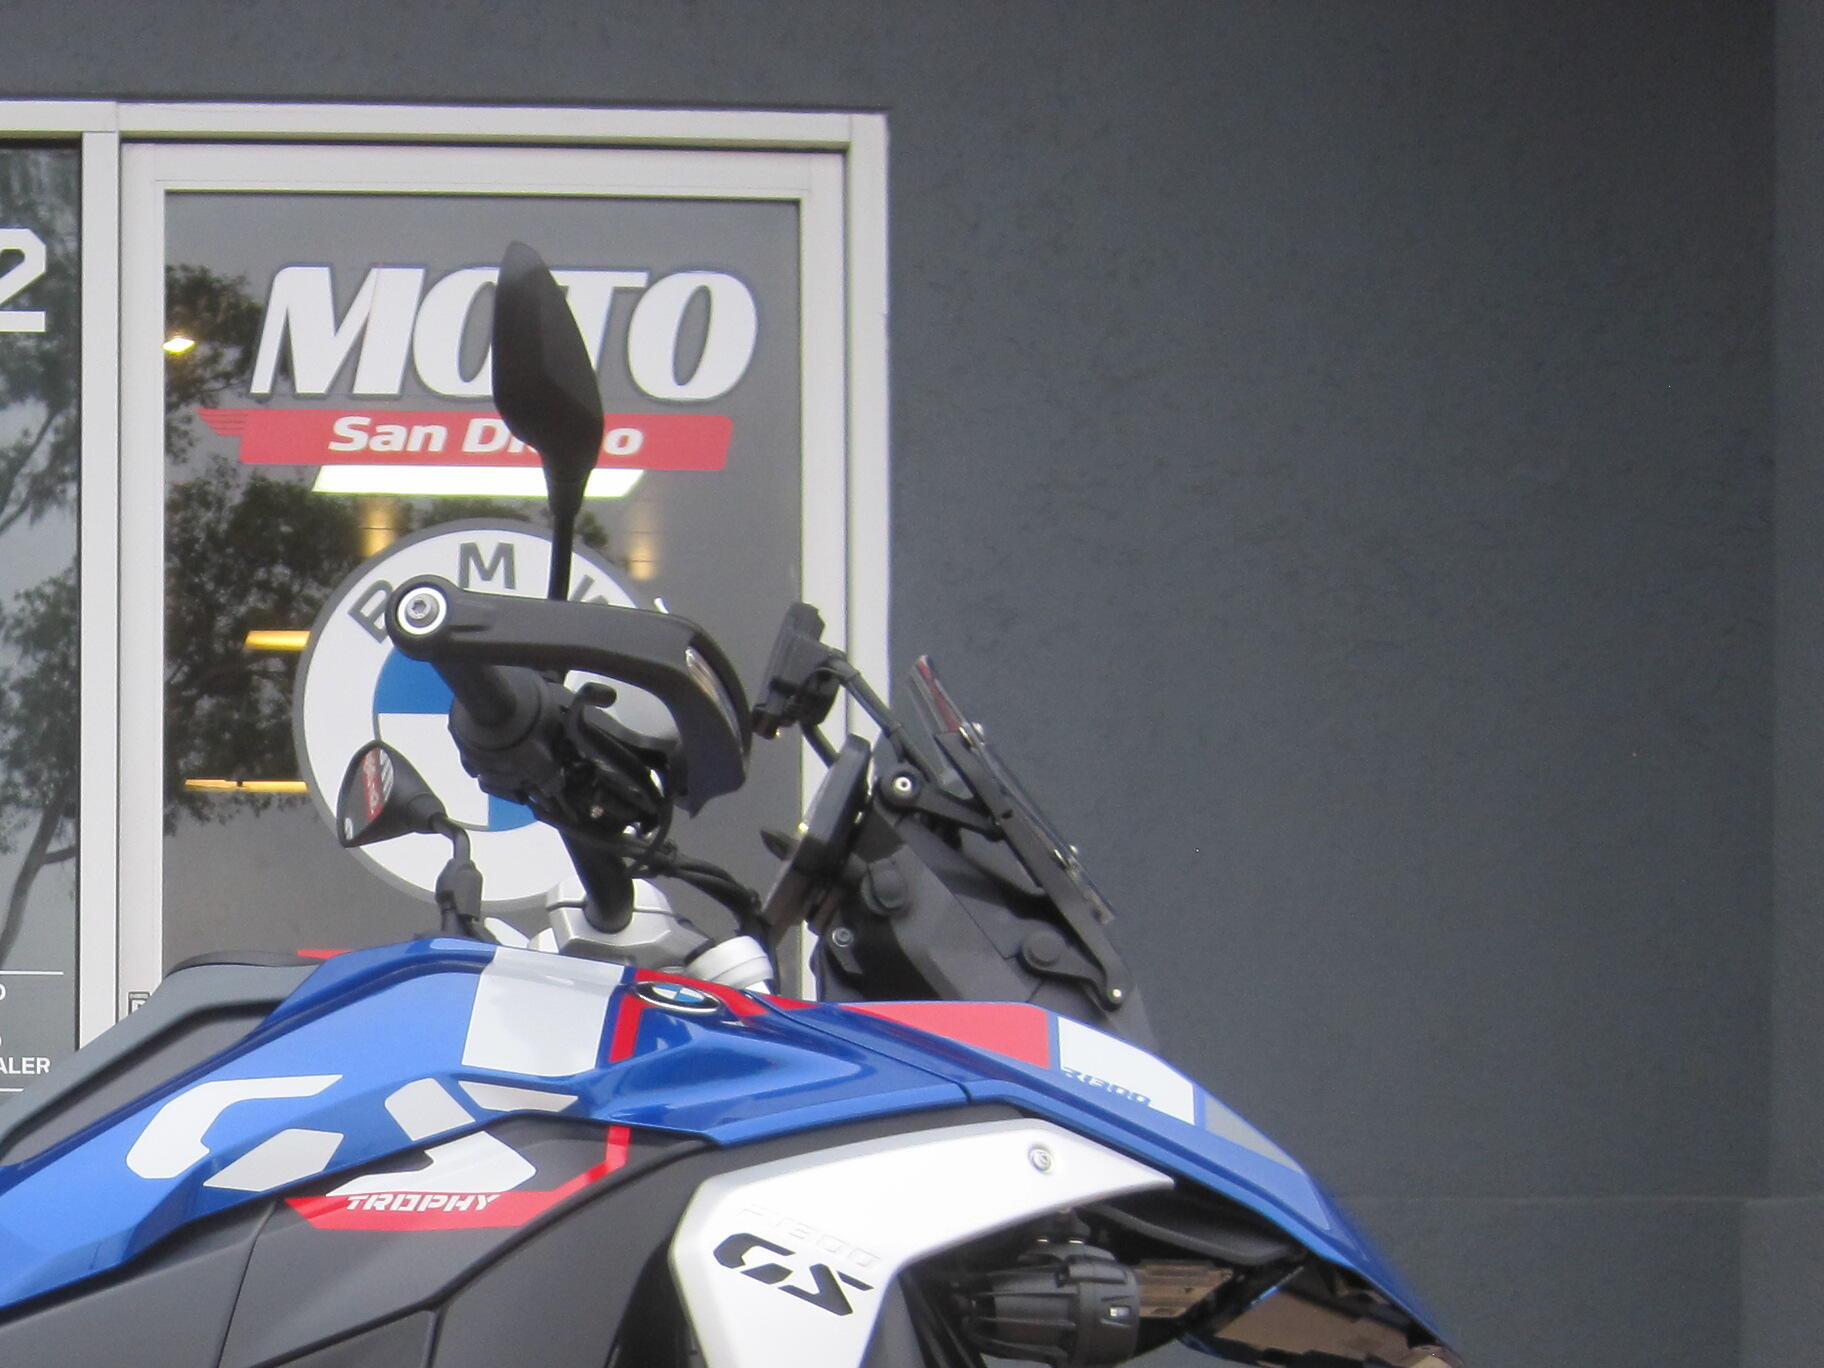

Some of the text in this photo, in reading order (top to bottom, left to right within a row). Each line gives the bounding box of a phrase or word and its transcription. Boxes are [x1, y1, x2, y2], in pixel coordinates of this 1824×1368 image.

[250, 266, 758, 400] MOTO
[328, 416, 447, 452] San
[348, 541, 608, 644] BM
[346, 1193, 502, 1212] TROPHY
[713, 1232, 875, 1317] GS
